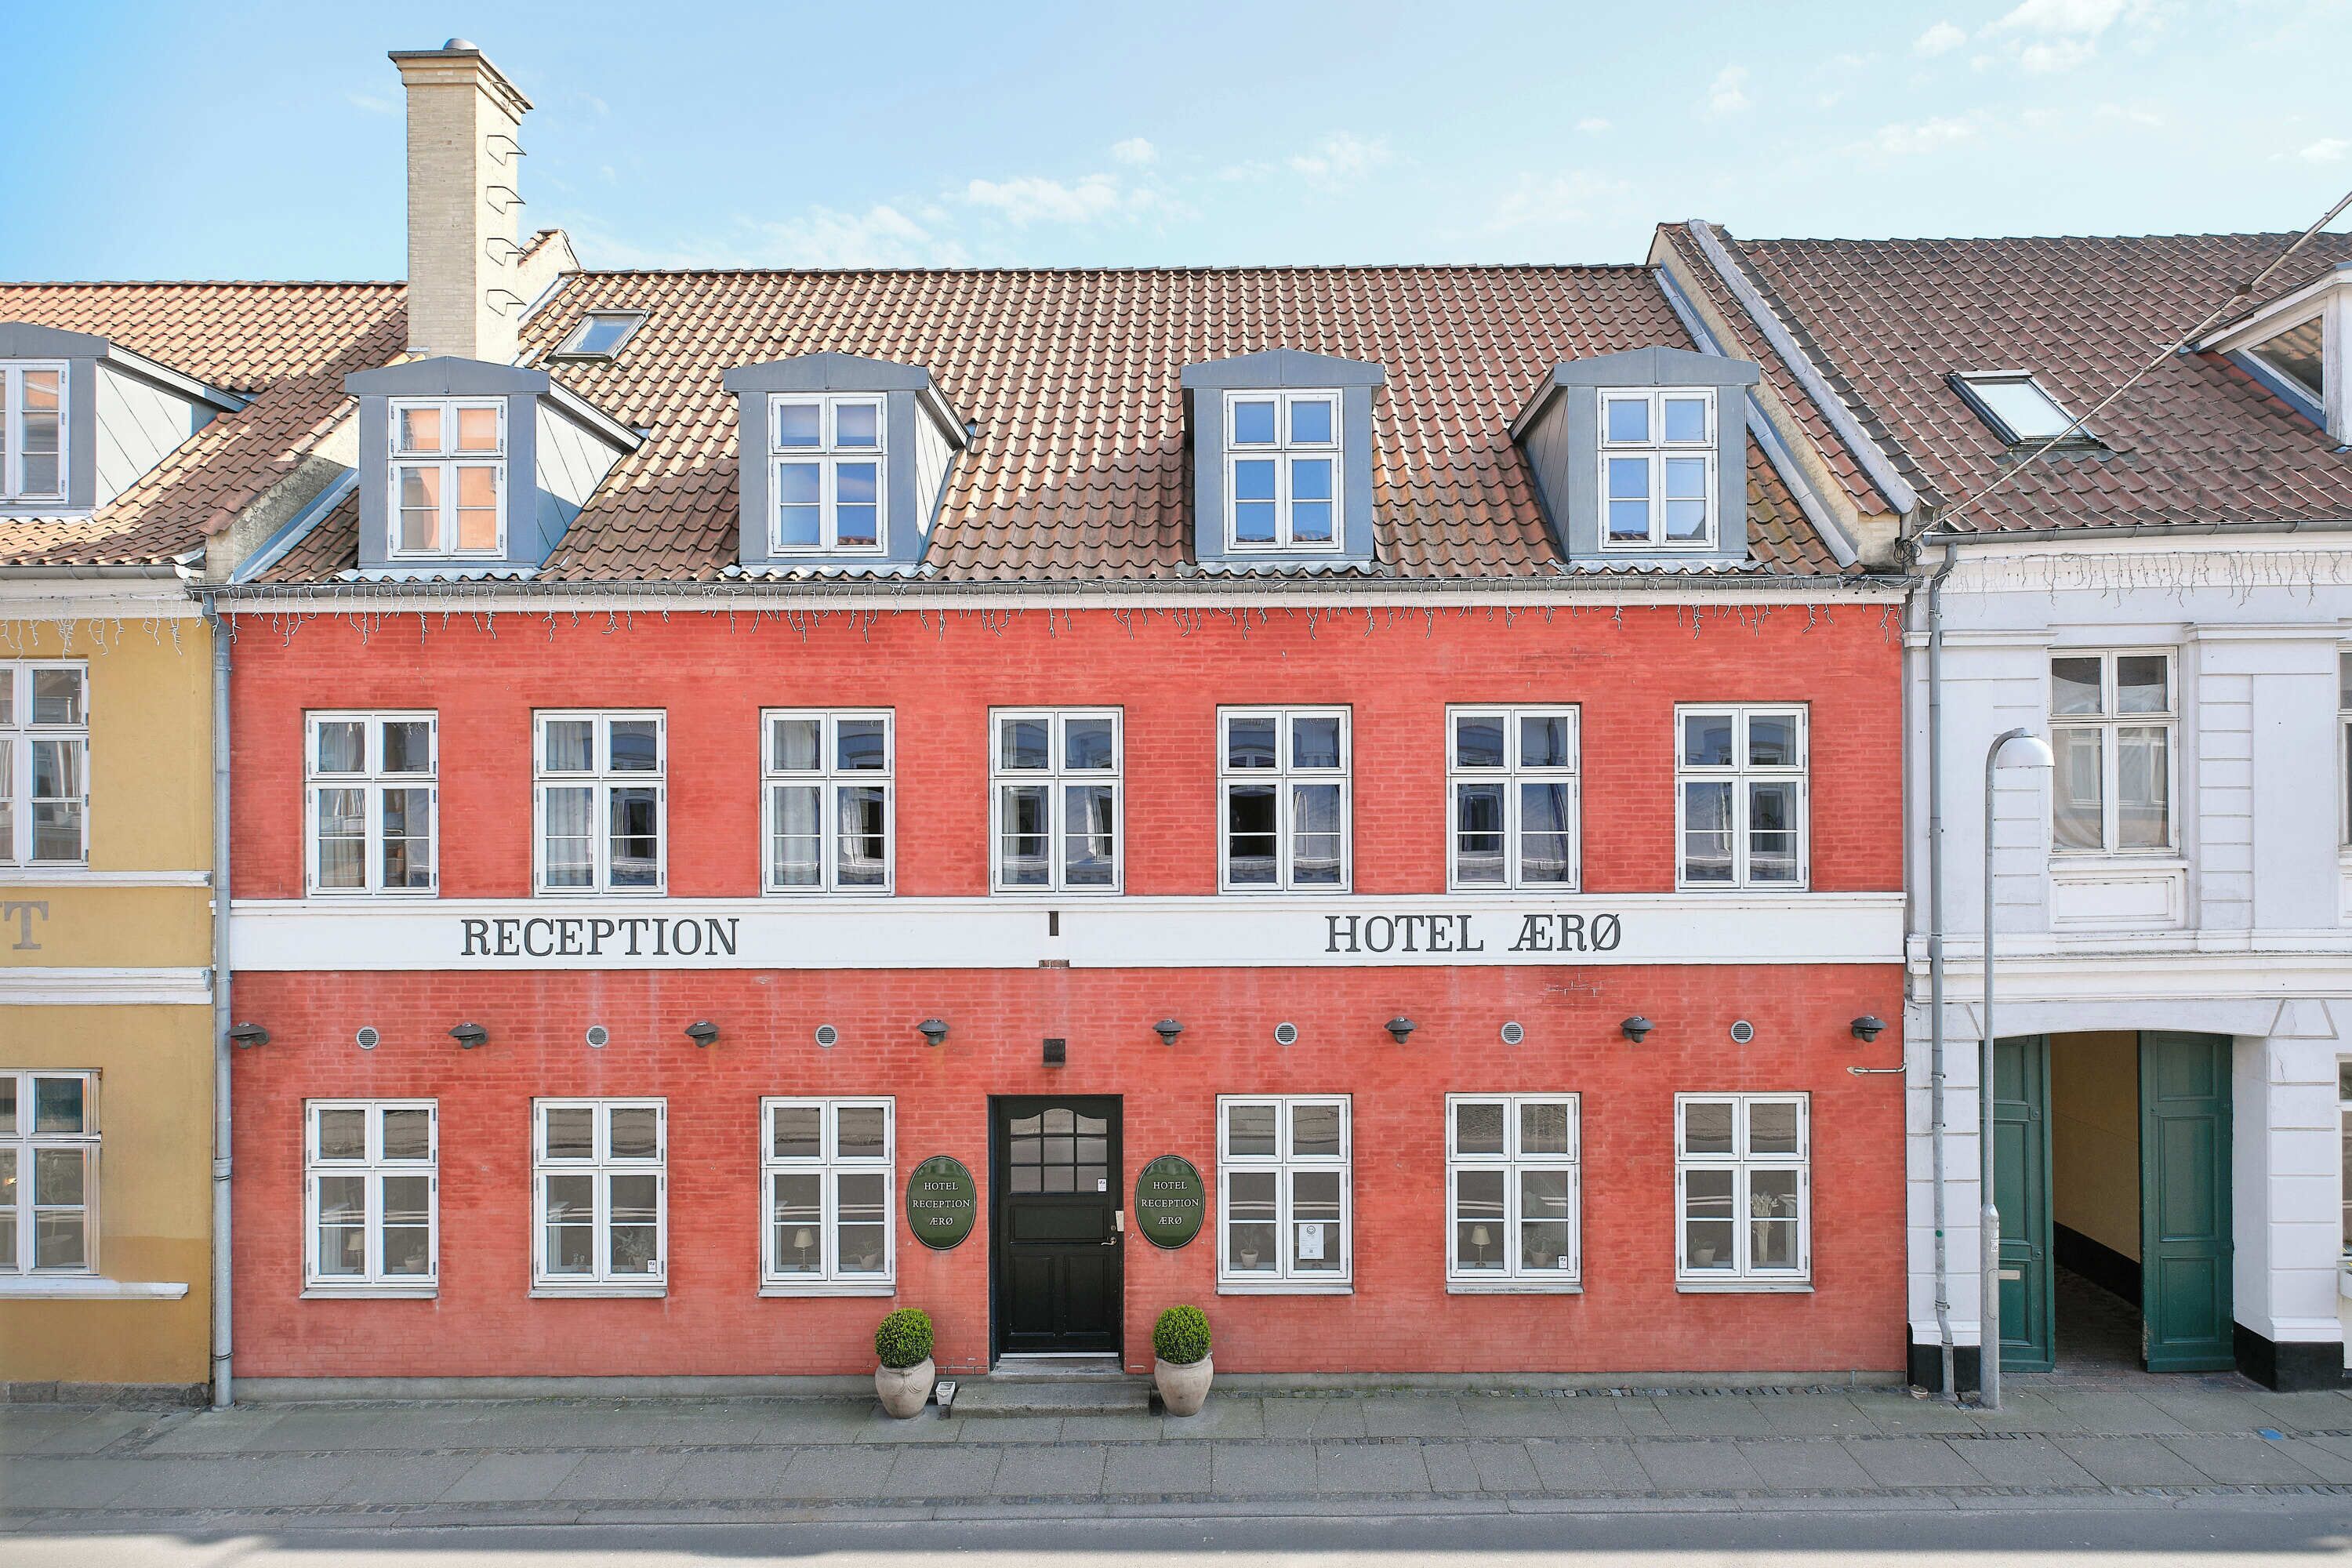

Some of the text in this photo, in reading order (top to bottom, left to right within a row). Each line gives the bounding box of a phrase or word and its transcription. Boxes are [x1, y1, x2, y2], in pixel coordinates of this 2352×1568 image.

[0, 901, 49, 950] T
[460, 918, 740, 956] RECEPTION
[1324, 913, 1621, 953] HOTEL ÆRØ
[924, 1181, 959, 1191] HOTEL
[1153, 1181, 1188, 1190] HOTEL
[913, 1199, 971, 1208] RECEPTION
[1141, 1199, 1199, 1207] RECEPTION
[929, 1217, 953, 1225] ÆRØ
[1158, 1216, 1182, 1225] ÆRØ
